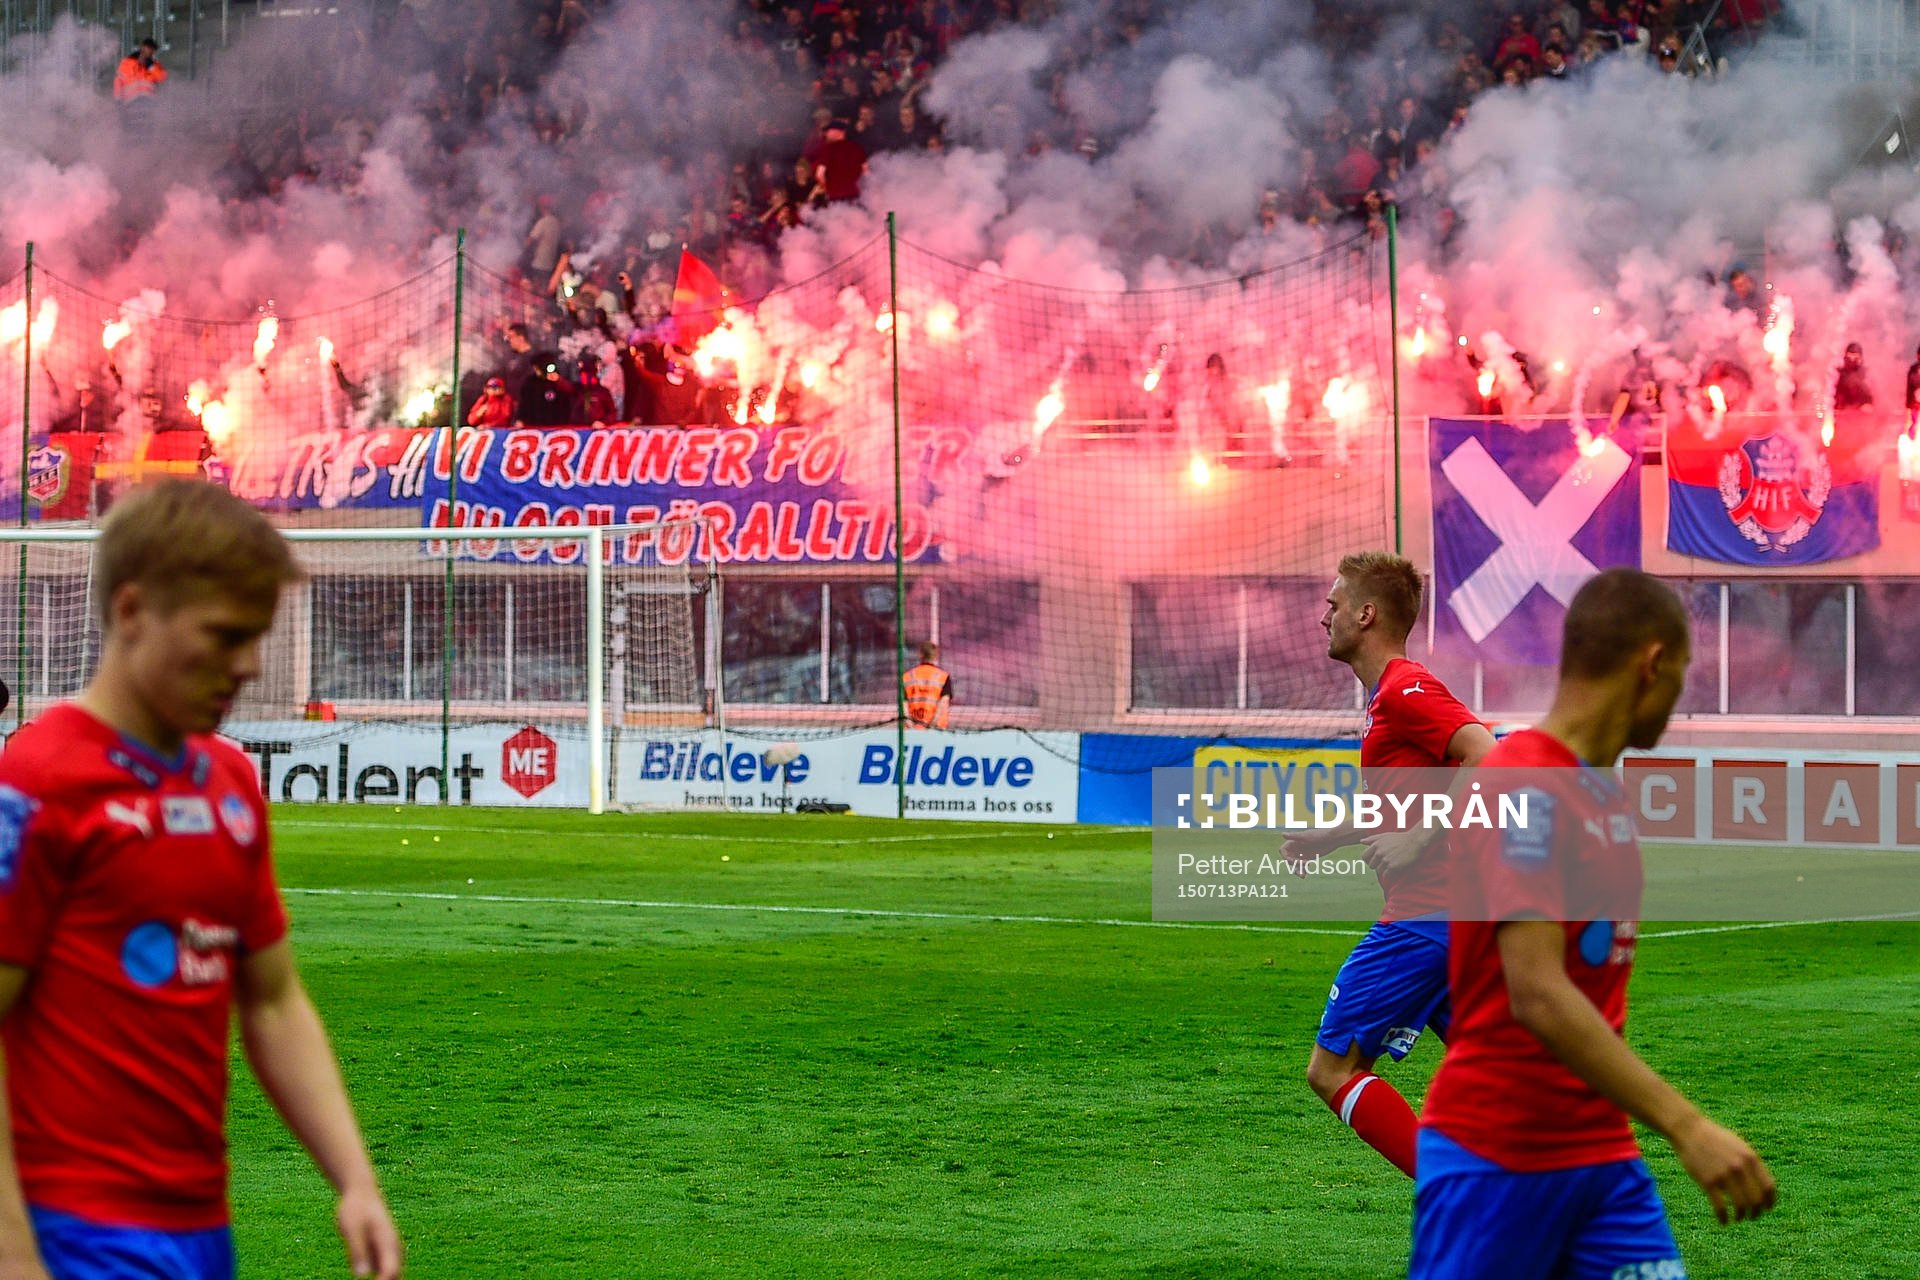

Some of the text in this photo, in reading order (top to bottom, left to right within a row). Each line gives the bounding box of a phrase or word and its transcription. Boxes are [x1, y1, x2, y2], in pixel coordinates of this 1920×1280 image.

[433, 427, 495, 484] VI
[500, 427, 760, 490] BRINNER
[1753, 485, 1793, 513] HIF
[243, 741, 484, 806] Talent
[508, 747, 549, 776] ME
[640, 741, 810, 783] Bildeve
[859, 744, 1034, 788] Bildeve
[904, 796, 1053, 813] hemma hos oss
[1206, 759, 1298, 813] CITY
